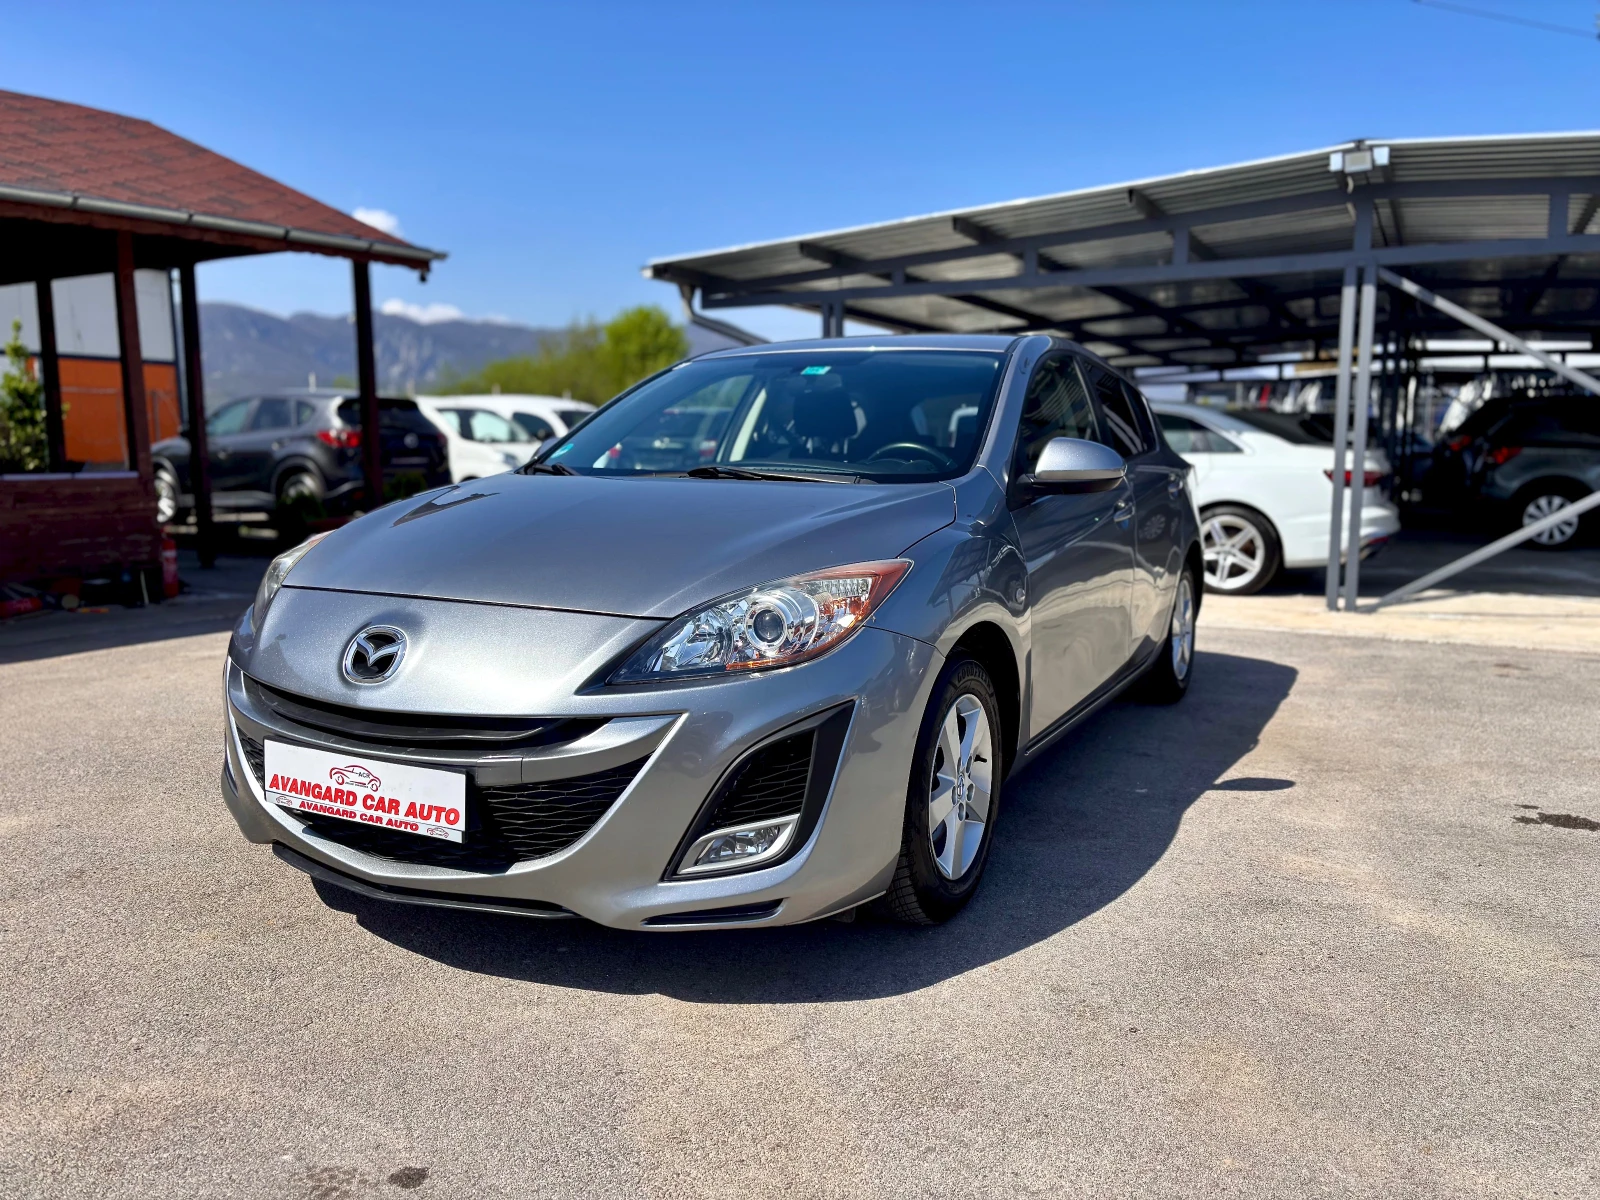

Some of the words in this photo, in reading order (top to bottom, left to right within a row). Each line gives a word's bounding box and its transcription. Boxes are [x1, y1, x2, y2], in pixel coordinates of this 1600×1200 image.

[269, 773, 357, 806] AVANGARD
[362, 794, 400, 815] CAR
[404, 802, 460, 825] AUTO
[299, 801, 357, 819] AVANGARD
[360, 813, 383, 825] CAR
[386, 819, 419, 831] AUTO
